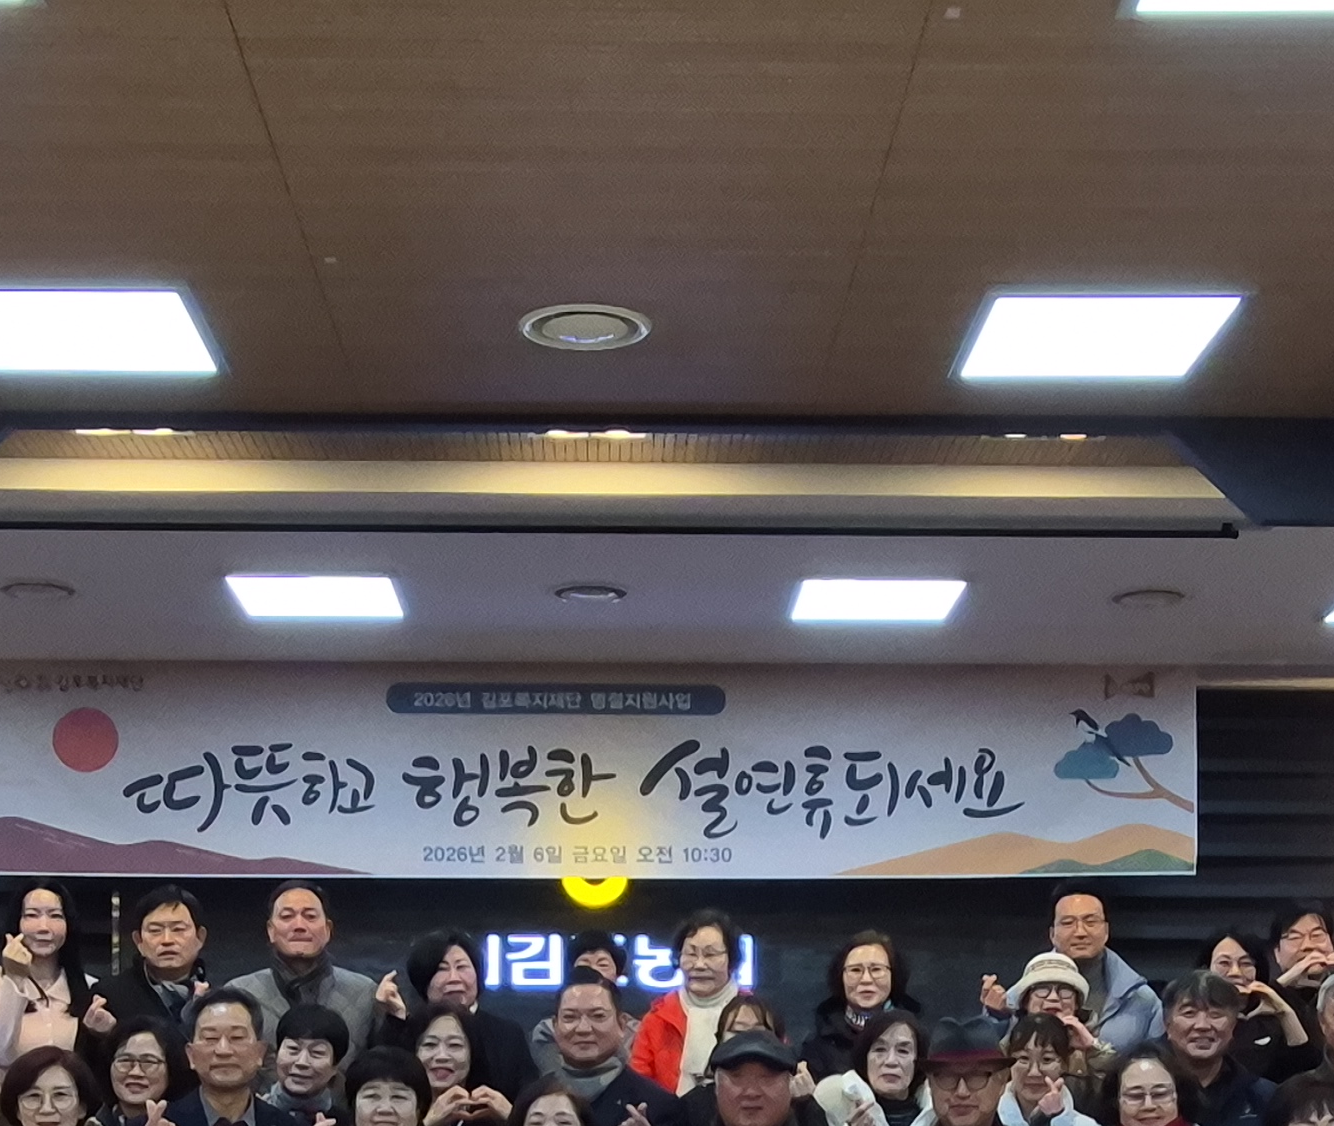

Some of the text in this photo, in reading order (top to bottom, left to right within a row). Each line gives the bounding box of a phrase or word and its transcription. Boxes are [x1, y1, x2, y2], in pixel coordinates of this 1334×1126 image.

[122, 742, 376, 833] 따뜻하고
[402, 744, 616, 828] 행복한
[423, 845, 733, 865] 2026년 2월 6일 금요일 오전 10:30
